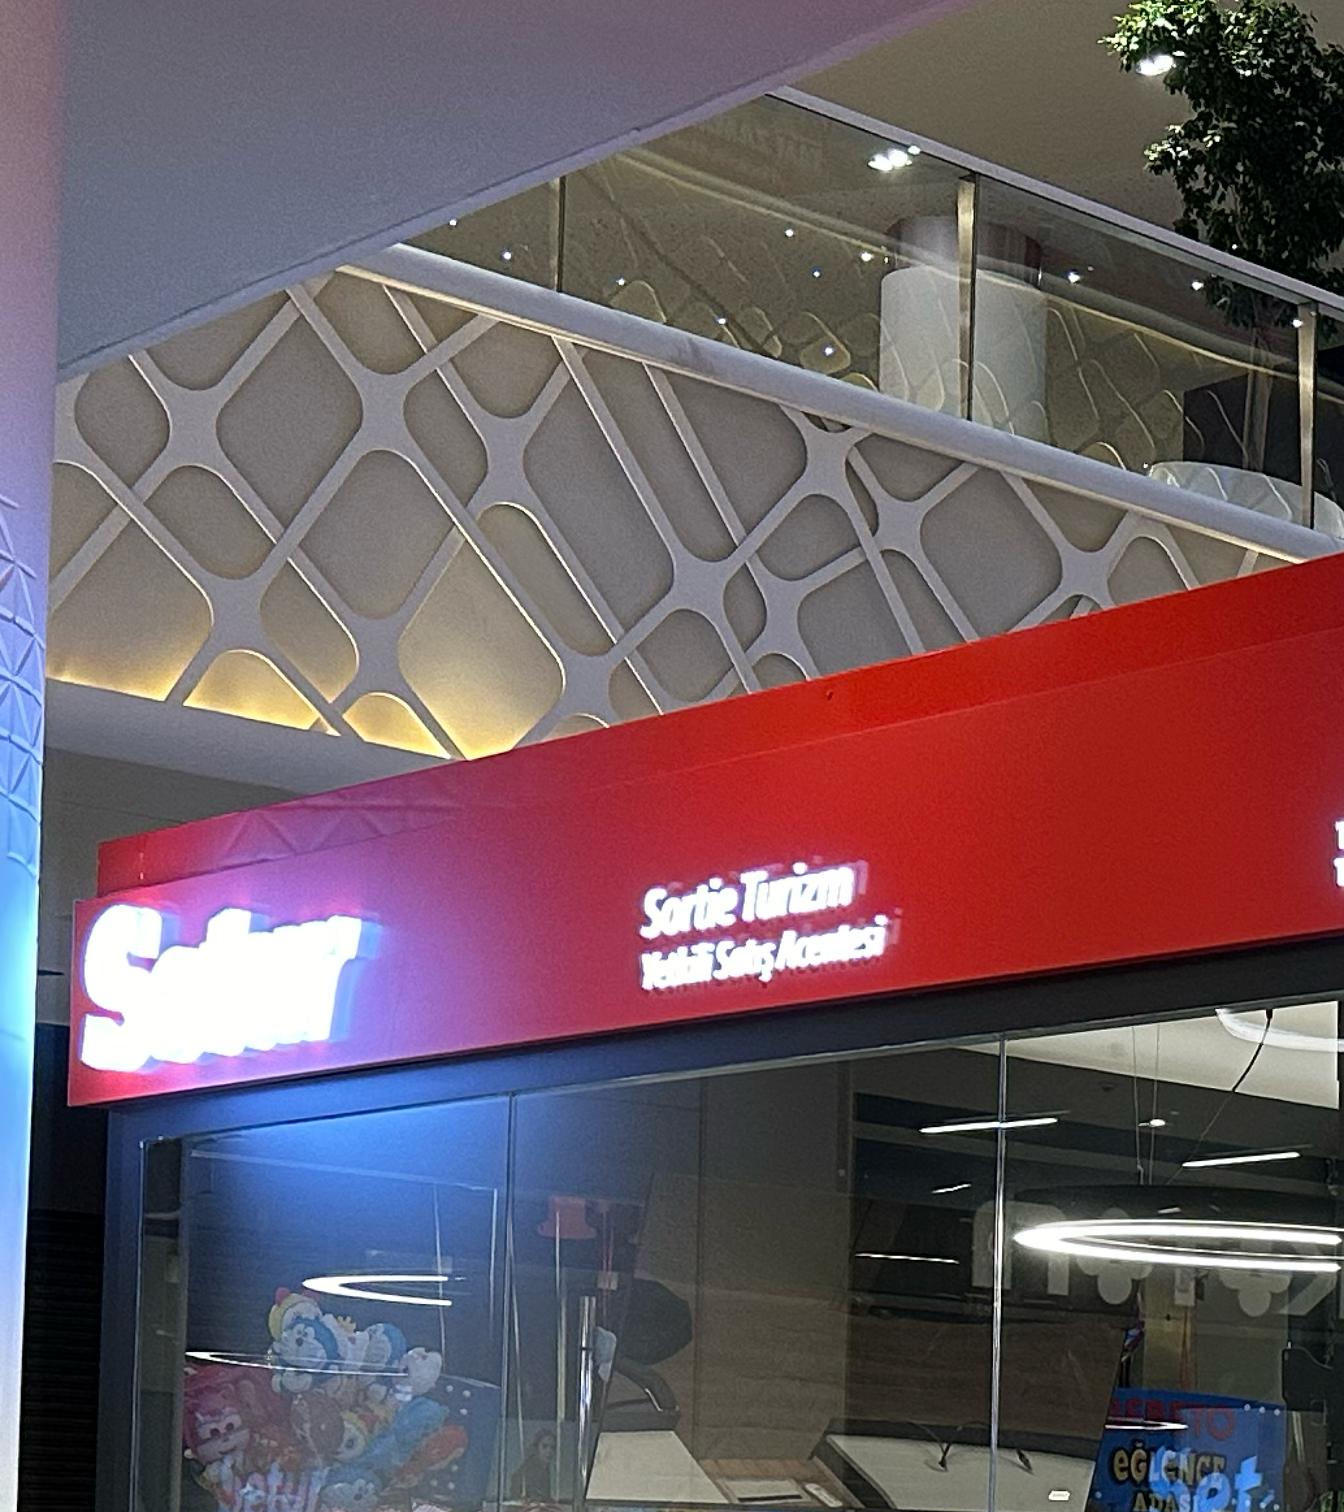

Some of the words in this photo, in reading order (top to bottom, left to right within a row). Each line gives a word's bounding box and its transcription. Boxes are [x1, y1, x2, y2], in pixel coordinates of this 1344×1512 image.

[640, 877, 737, 939] Sortie
[739, 862, 855, 922] Turizm
[81, 903, 364, 1071] Setur
